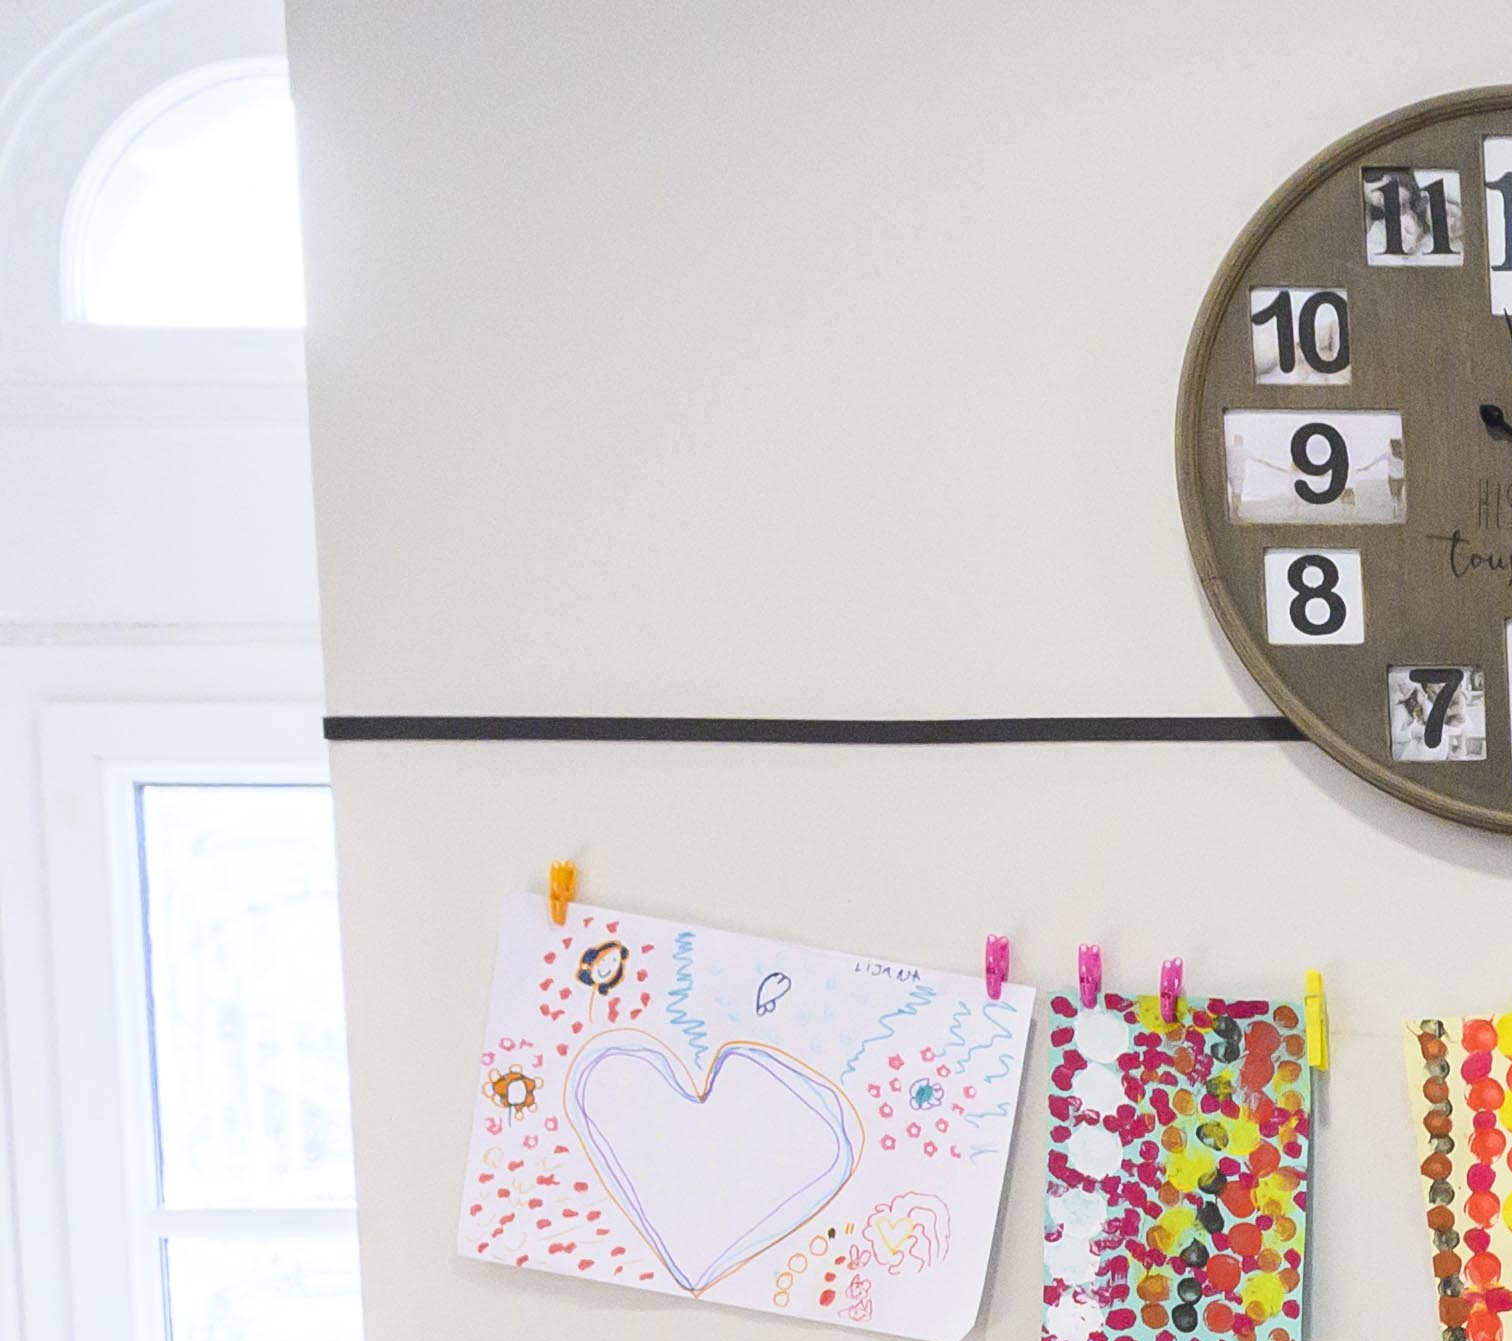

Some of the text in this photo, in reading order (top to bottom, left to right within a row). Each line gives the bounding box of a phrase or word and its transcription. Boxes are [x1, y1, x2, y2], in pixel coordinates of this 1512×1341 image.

[1368, 177, 1462, 257] 11
[1250, 290, 1351, 374] 10
[1290, 423, 1350, 504] 9
[1286, 554, 1347, 635] 8
[1409, 668, 1464, 749] 7
